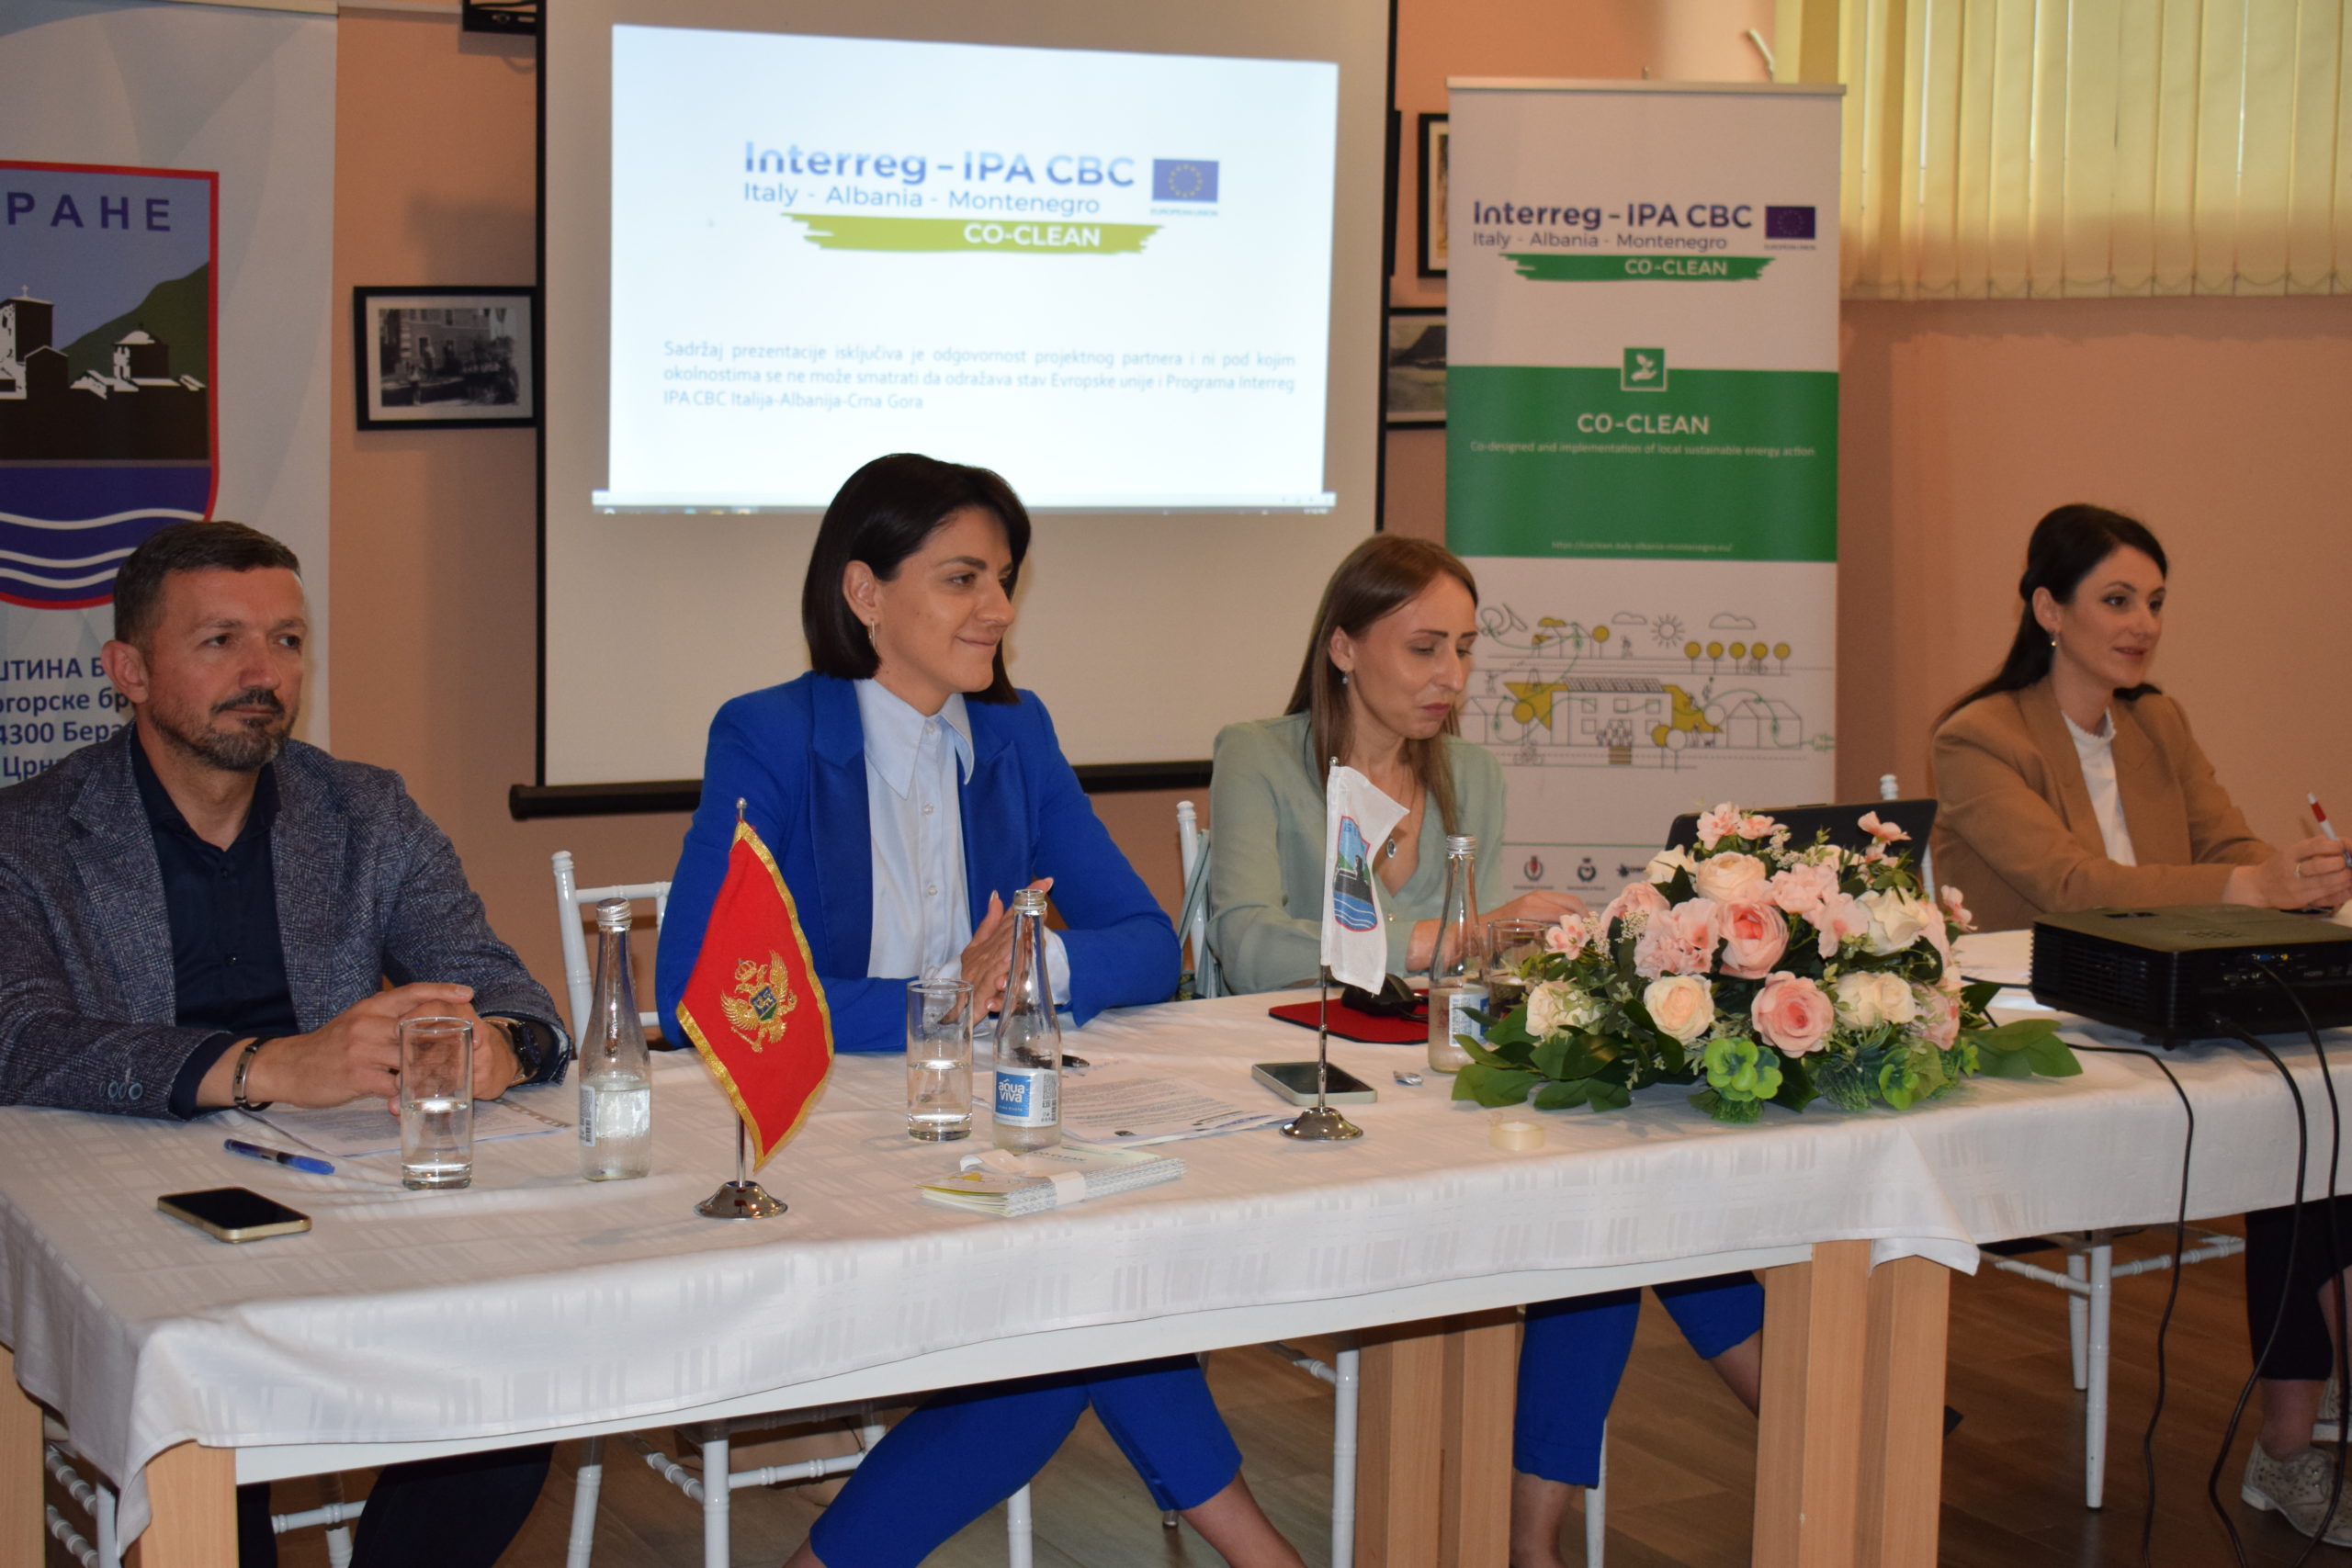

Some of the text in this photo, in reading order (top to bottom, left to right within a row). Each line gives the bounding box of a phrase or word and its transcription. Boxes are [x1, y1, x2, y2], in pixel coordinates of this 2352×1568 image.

[745, 141, 926, 185] Interreg
[964, 151, 1035, 184] IPA
[1046, 154, 1136, 187] CBC
[744, 183, 798, 207] Italy
[825, 186, 923, 208] Albania
[949, 190, 1100, 217] Montenegro
[1474, 201, 1601, 230] Interreg
[1627, 204, 1679, 228] IPA
[1687, 205, 1753, 229] CBC
[964, 223, 1101, 247] CO-CLEAN
[1473, 231, 1510, 249] Italy
[1530, 233, 1599, 248] Albania
[1617, 234, 1727, 252] Montenegro
[1624, 259, 1728, 276] CO-CLEAN
[732, 344, 826, 364] prezentacije
[911, 348, 924, 366] je
[933, 347, 1026, 366] odgovornost
[1035, 349, 1114, 368] projektnog
[1122, 351, 1182, 368] partnera
[1223, 351, 1250, 368] pod
[1257, 352, 1295, 369] kojim
[663, 366, 761, 382] okolnostima
[766, 370, 782, 382] se
[787, 371, 805, 383] ne
[810, 367, 852, 384] može
[856, 370, 919, 385] smatrati
[923, 370, 941, 385] da
[1017, 373, 1046, 387] stav
[1051, 372, 1115, 390] Evropske
[1120, 374, 1154, 391] unije
[1166, 374, 1235, 393] Programa
[1239, 375, 1295, 394] Interreg
[663, 389, 689, 405] IPA
[693, 390, 726, 406] CBC
[888, 393, 923, 409] Gora
[1577, 413, 1710, 434] CO-CLEAN
[1537, 441, 1557, 452] and
[1658, 445, 1681, 455] local
[1685, 445, 1742, 456] sustainable
[0, 687, 130, 716] горске бр
[1000, 1090, 1023, 1103] viva
